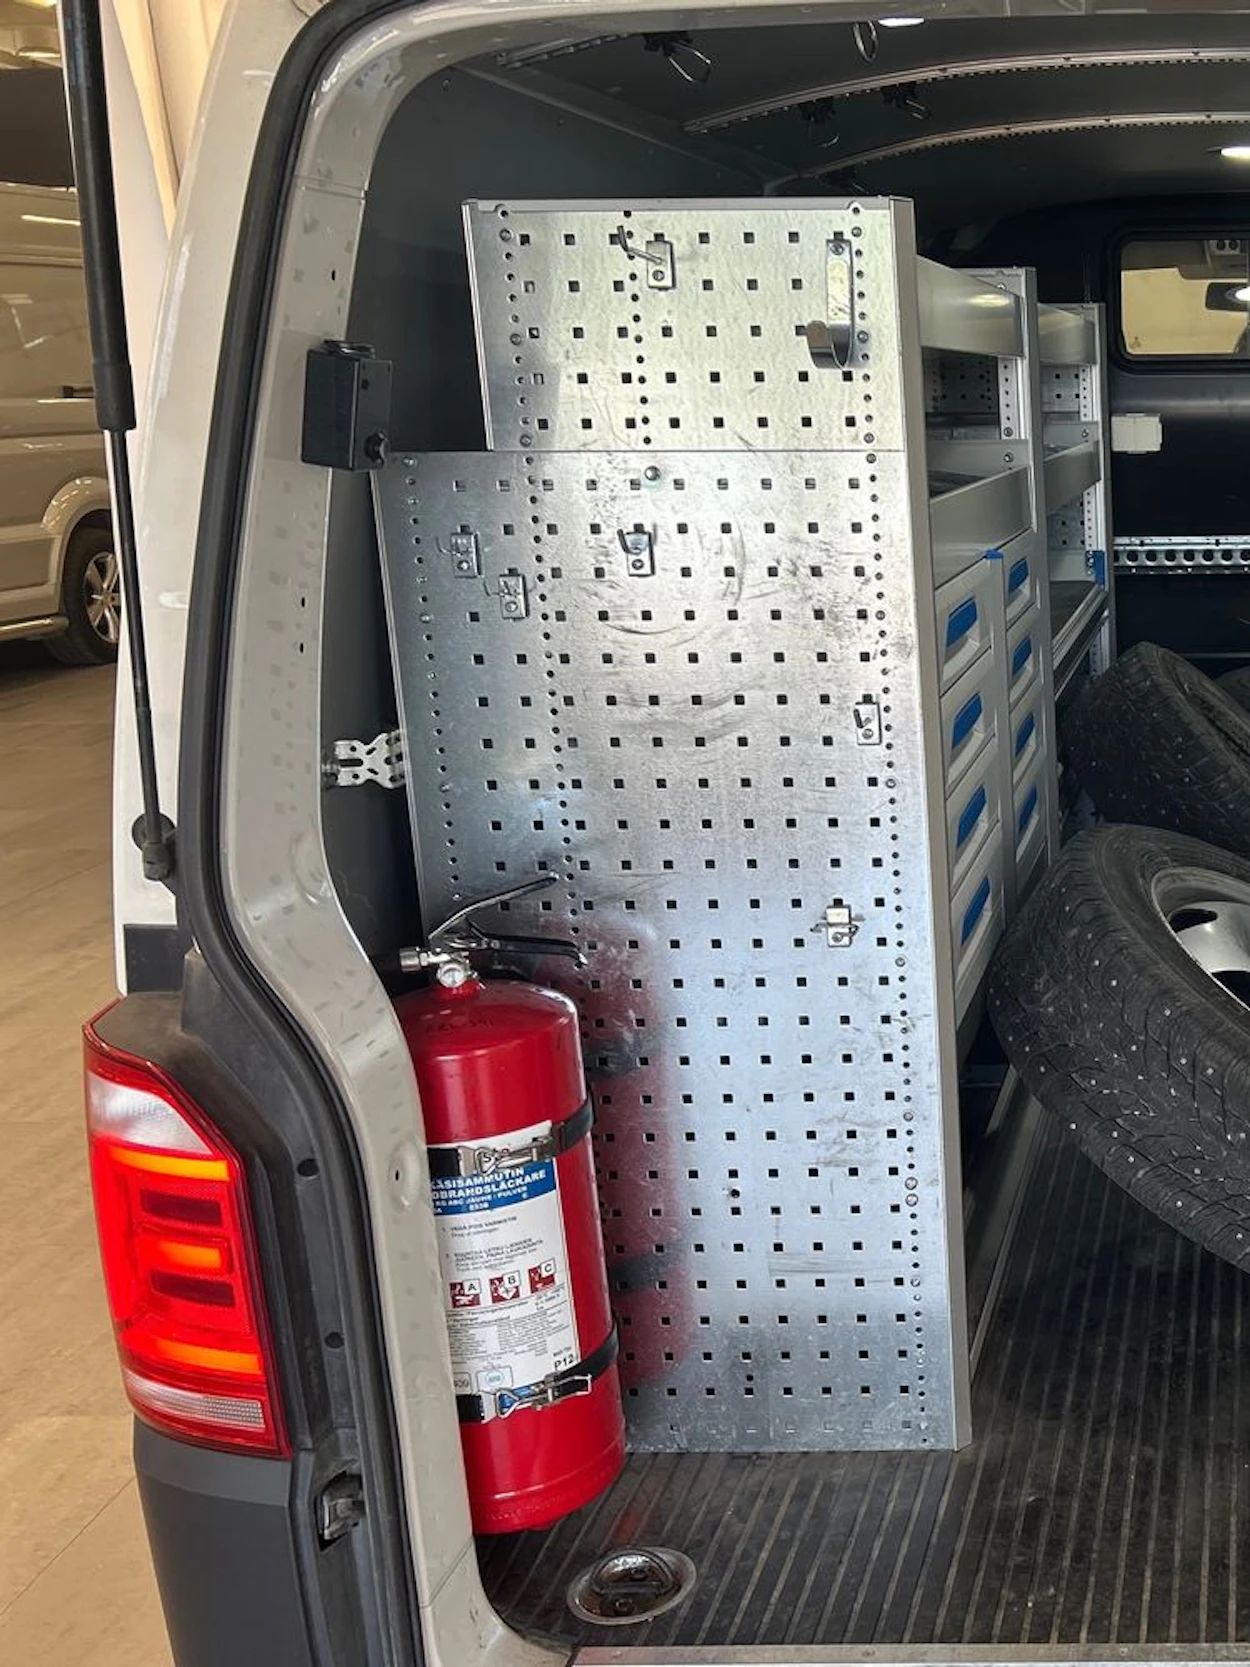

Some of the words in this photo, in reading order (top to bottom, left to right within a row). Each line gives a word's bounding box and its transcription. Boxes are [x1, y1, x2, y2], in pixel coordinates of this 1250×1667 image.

[544, 1263, 552, 1273] C
[507, 1275, 516, 1284] B
[468, 1283, 477, 1292] A
